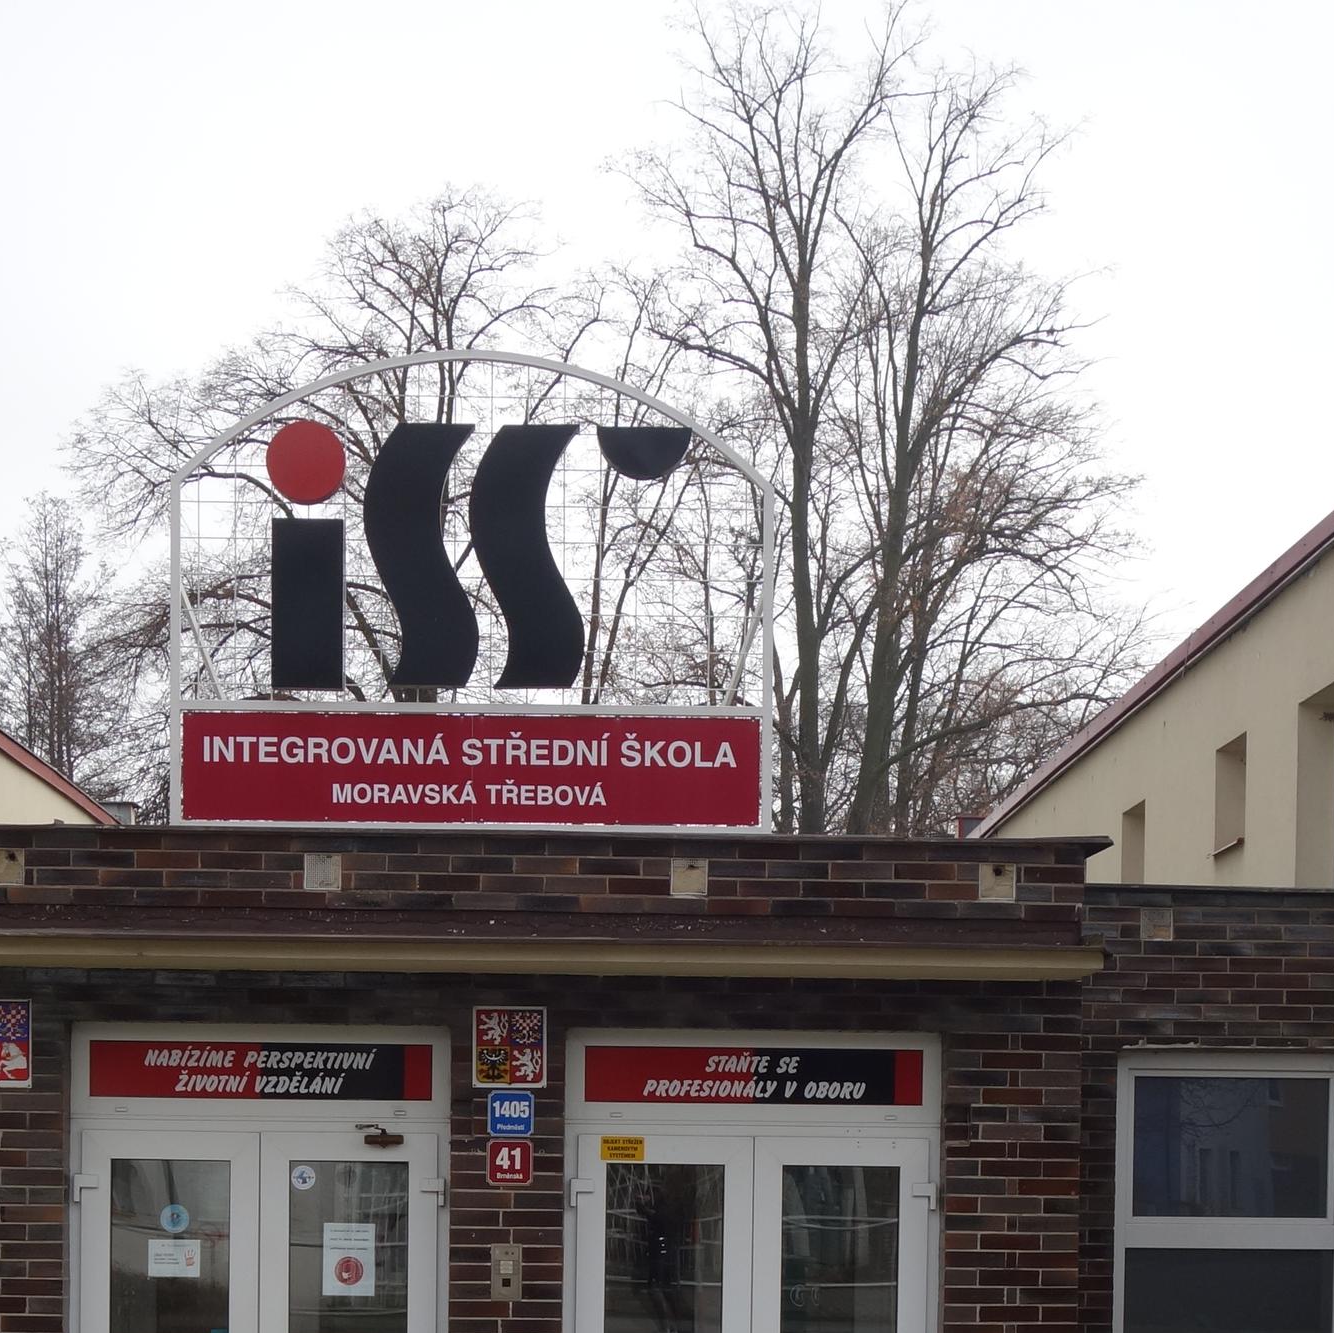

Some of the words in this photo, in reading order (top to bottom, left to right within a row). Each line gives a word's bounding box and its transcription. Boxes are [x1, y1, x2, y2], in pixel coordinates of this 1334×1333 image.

[203, 733, 450, 765] INTEGROVANÁ
[462, 732, 608, 767] STŘEDNÍ
[620, 733, 737, 768] ŠKOLA
[332, 781, 476, 805] MORAVSKÁ
[485, 780, 607, 806] TŘEBOVÁ
[144, 1046, 236, 1068] NABÍZÍME
[243, 1049, 377, 1071] PERSPEKTIVNÍ
[705, 1052, 770, 1073] STAŇTE
[776, 1056, 801, 1074] SE
[175, 1070, 251, 1093] ŽIVOTNÍ
[254, 1072, 346, 1095] VZDĚLÁNÍ
[642, 1076, 777, 1098] PROFESIONÁLY
[784, 1082, 798, 1099] V
[803, 1081, 867, 1100] OBORU
[492, 1100, 530, 1118] 1405
[495, 1146, 523, 1170] 41
